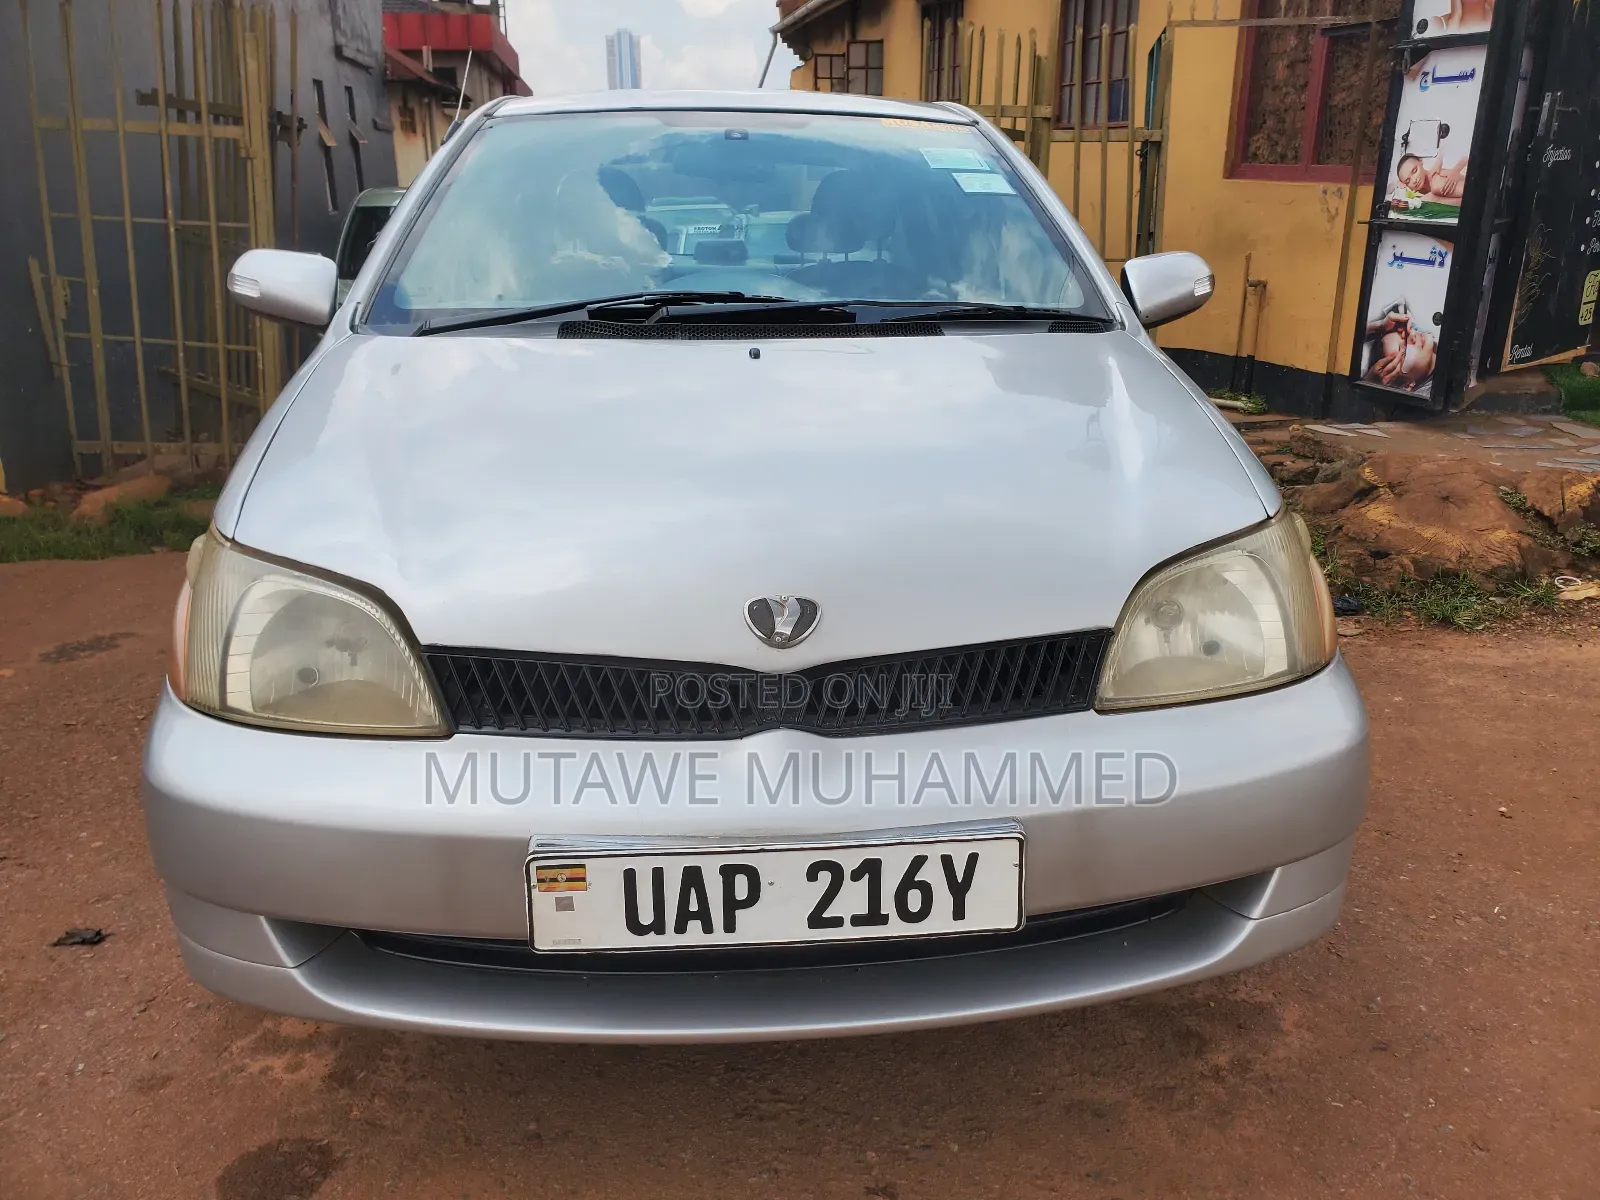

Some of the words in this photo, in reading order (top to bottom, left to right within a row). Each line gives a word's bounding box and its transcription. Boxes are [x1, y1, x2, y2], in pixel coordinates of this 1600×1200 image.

[1420, 65, 1476, 91] مساج
[623, 863, 762, 936] UAP
[806, 851, 980, 930] 216Y
